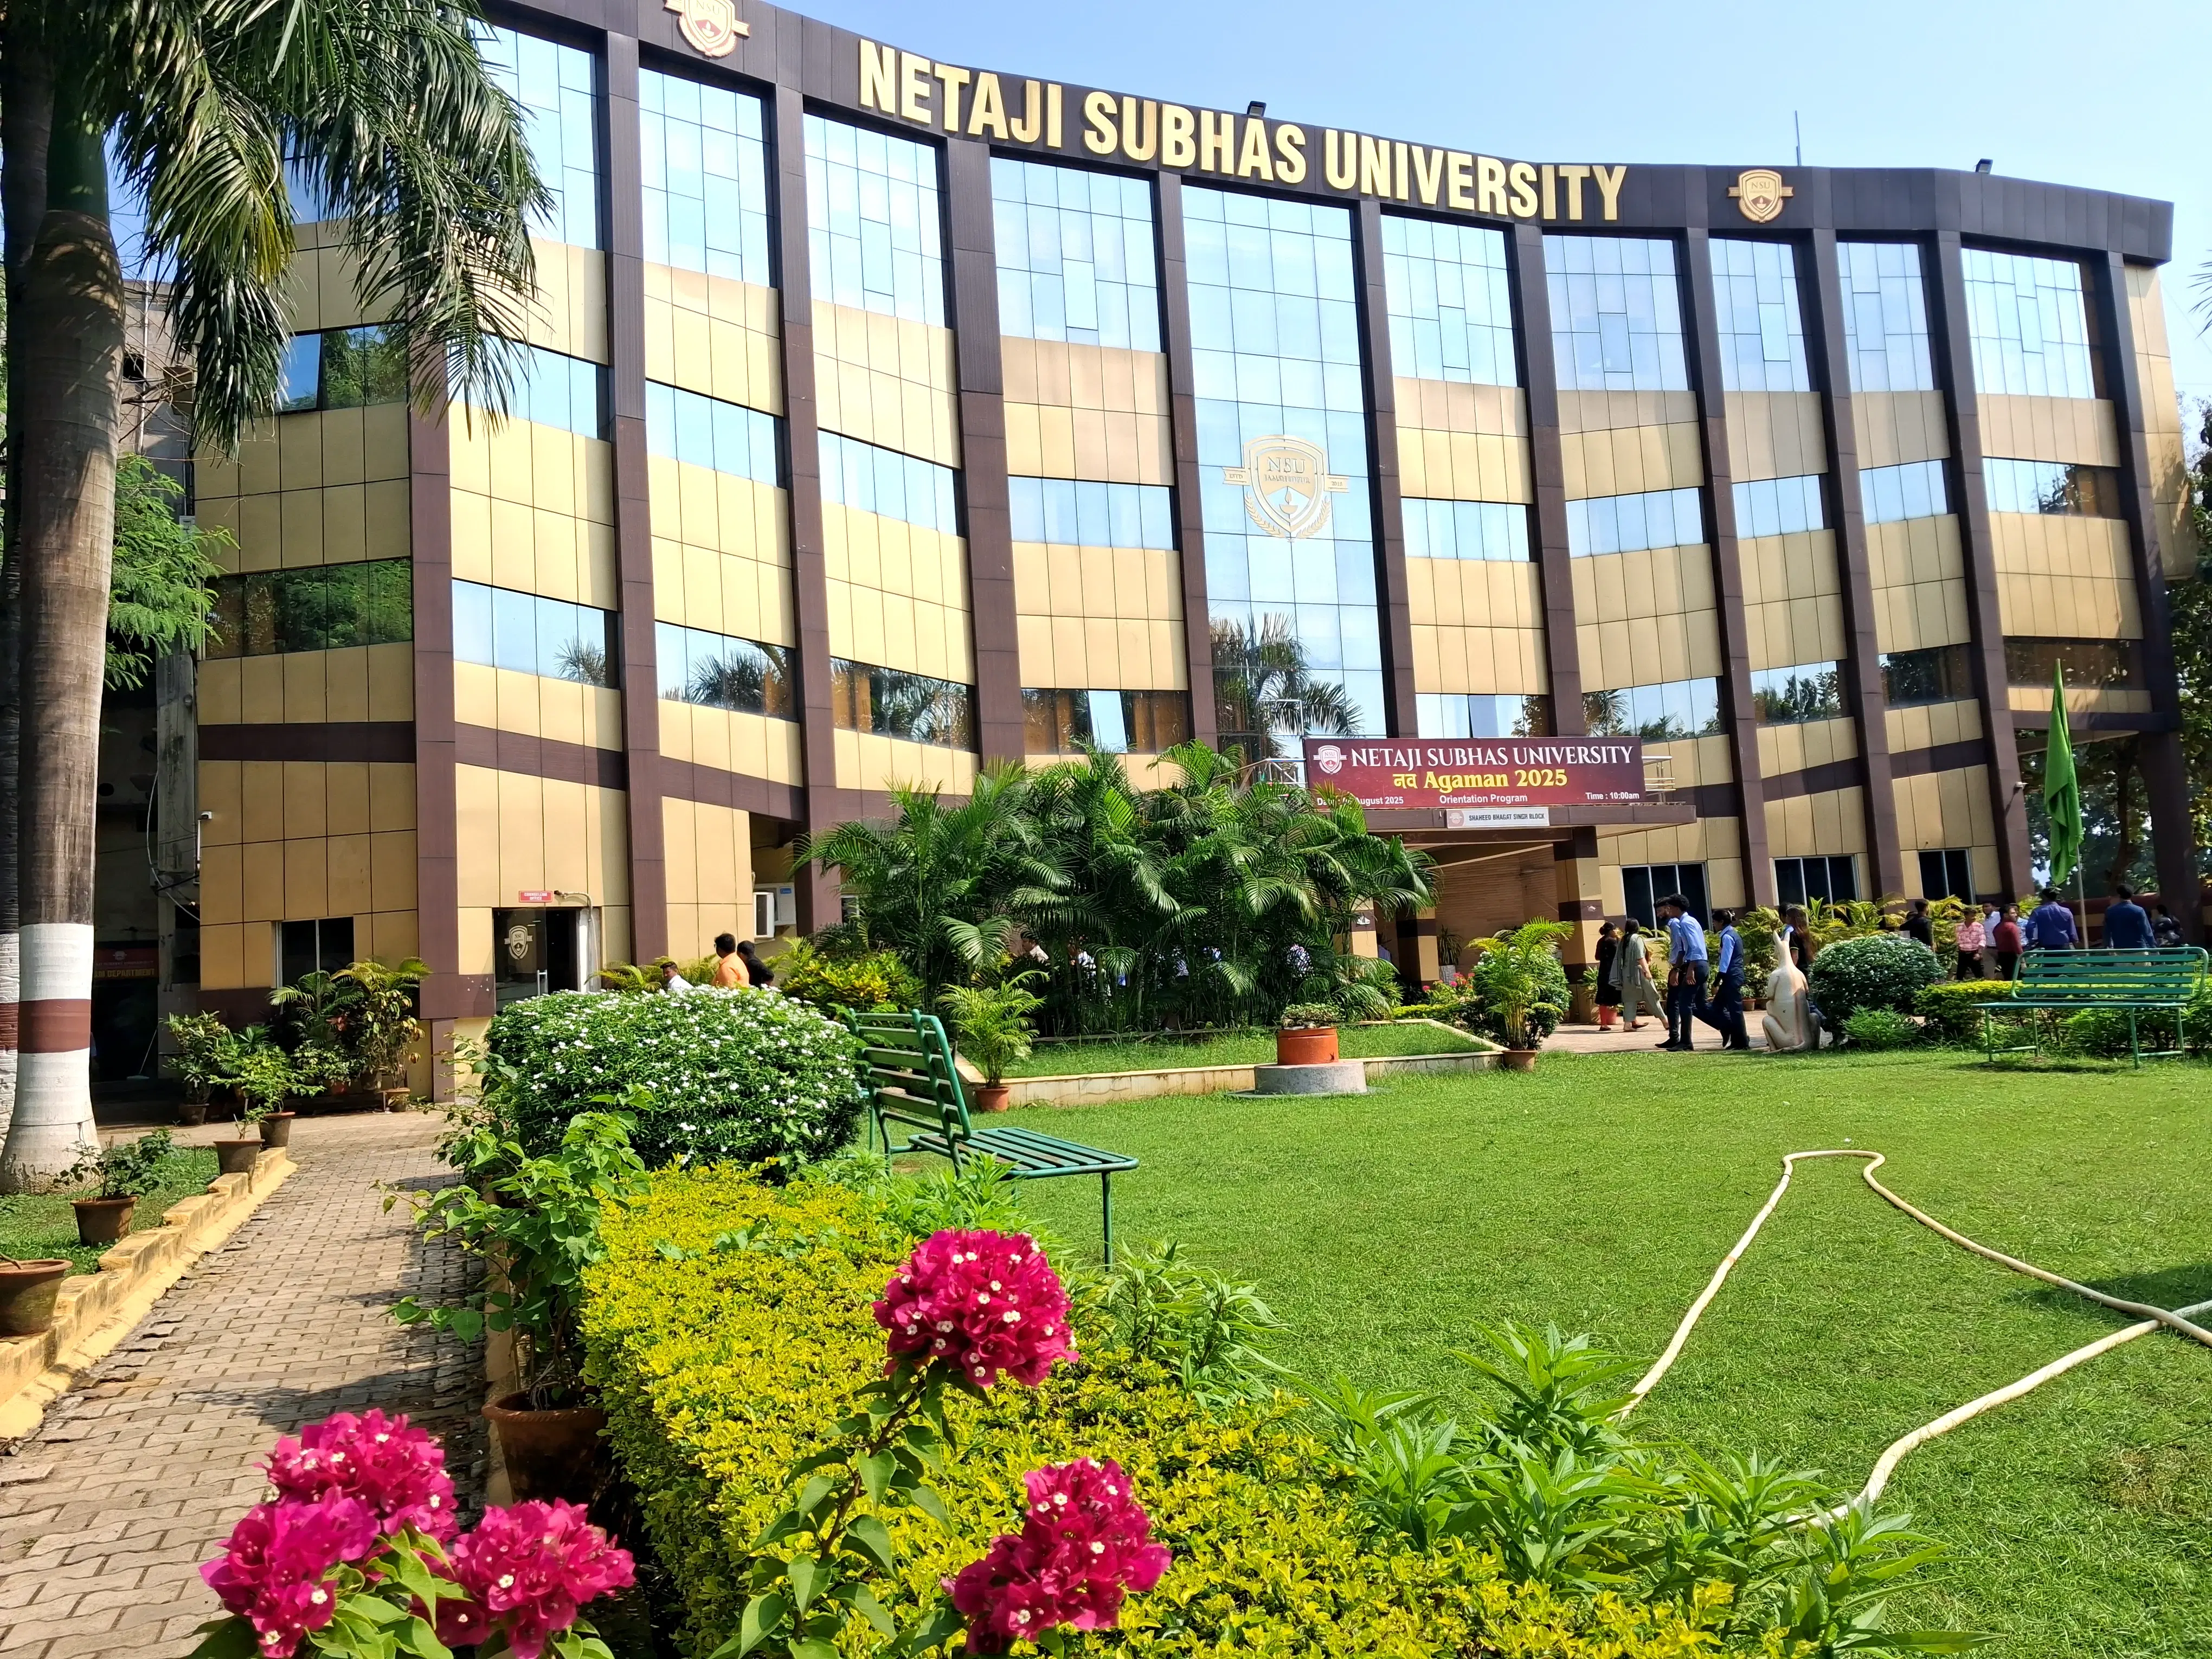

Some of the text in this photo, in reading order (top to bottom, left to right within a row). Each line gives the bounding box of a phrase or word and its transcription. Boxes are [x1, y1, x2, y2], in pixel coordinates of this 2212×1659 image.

[859, 37, 1627, 221] NETAJI SUBHAS UNIVERSITY
[1267, 456, 1306, 474] NSU
[1352, 745, 1634, 771] NETAJI SUBHAS UNIVERSITY
[1392, 773, 1417, 789] नव
[1423, 769, 1568, 794] Agaman 2025
[1385, 796, 1404, 805] 2025
[1439, 794, 1528, 805] Orientation Program
[107, 968, 155, 977] DEPARTMENT
